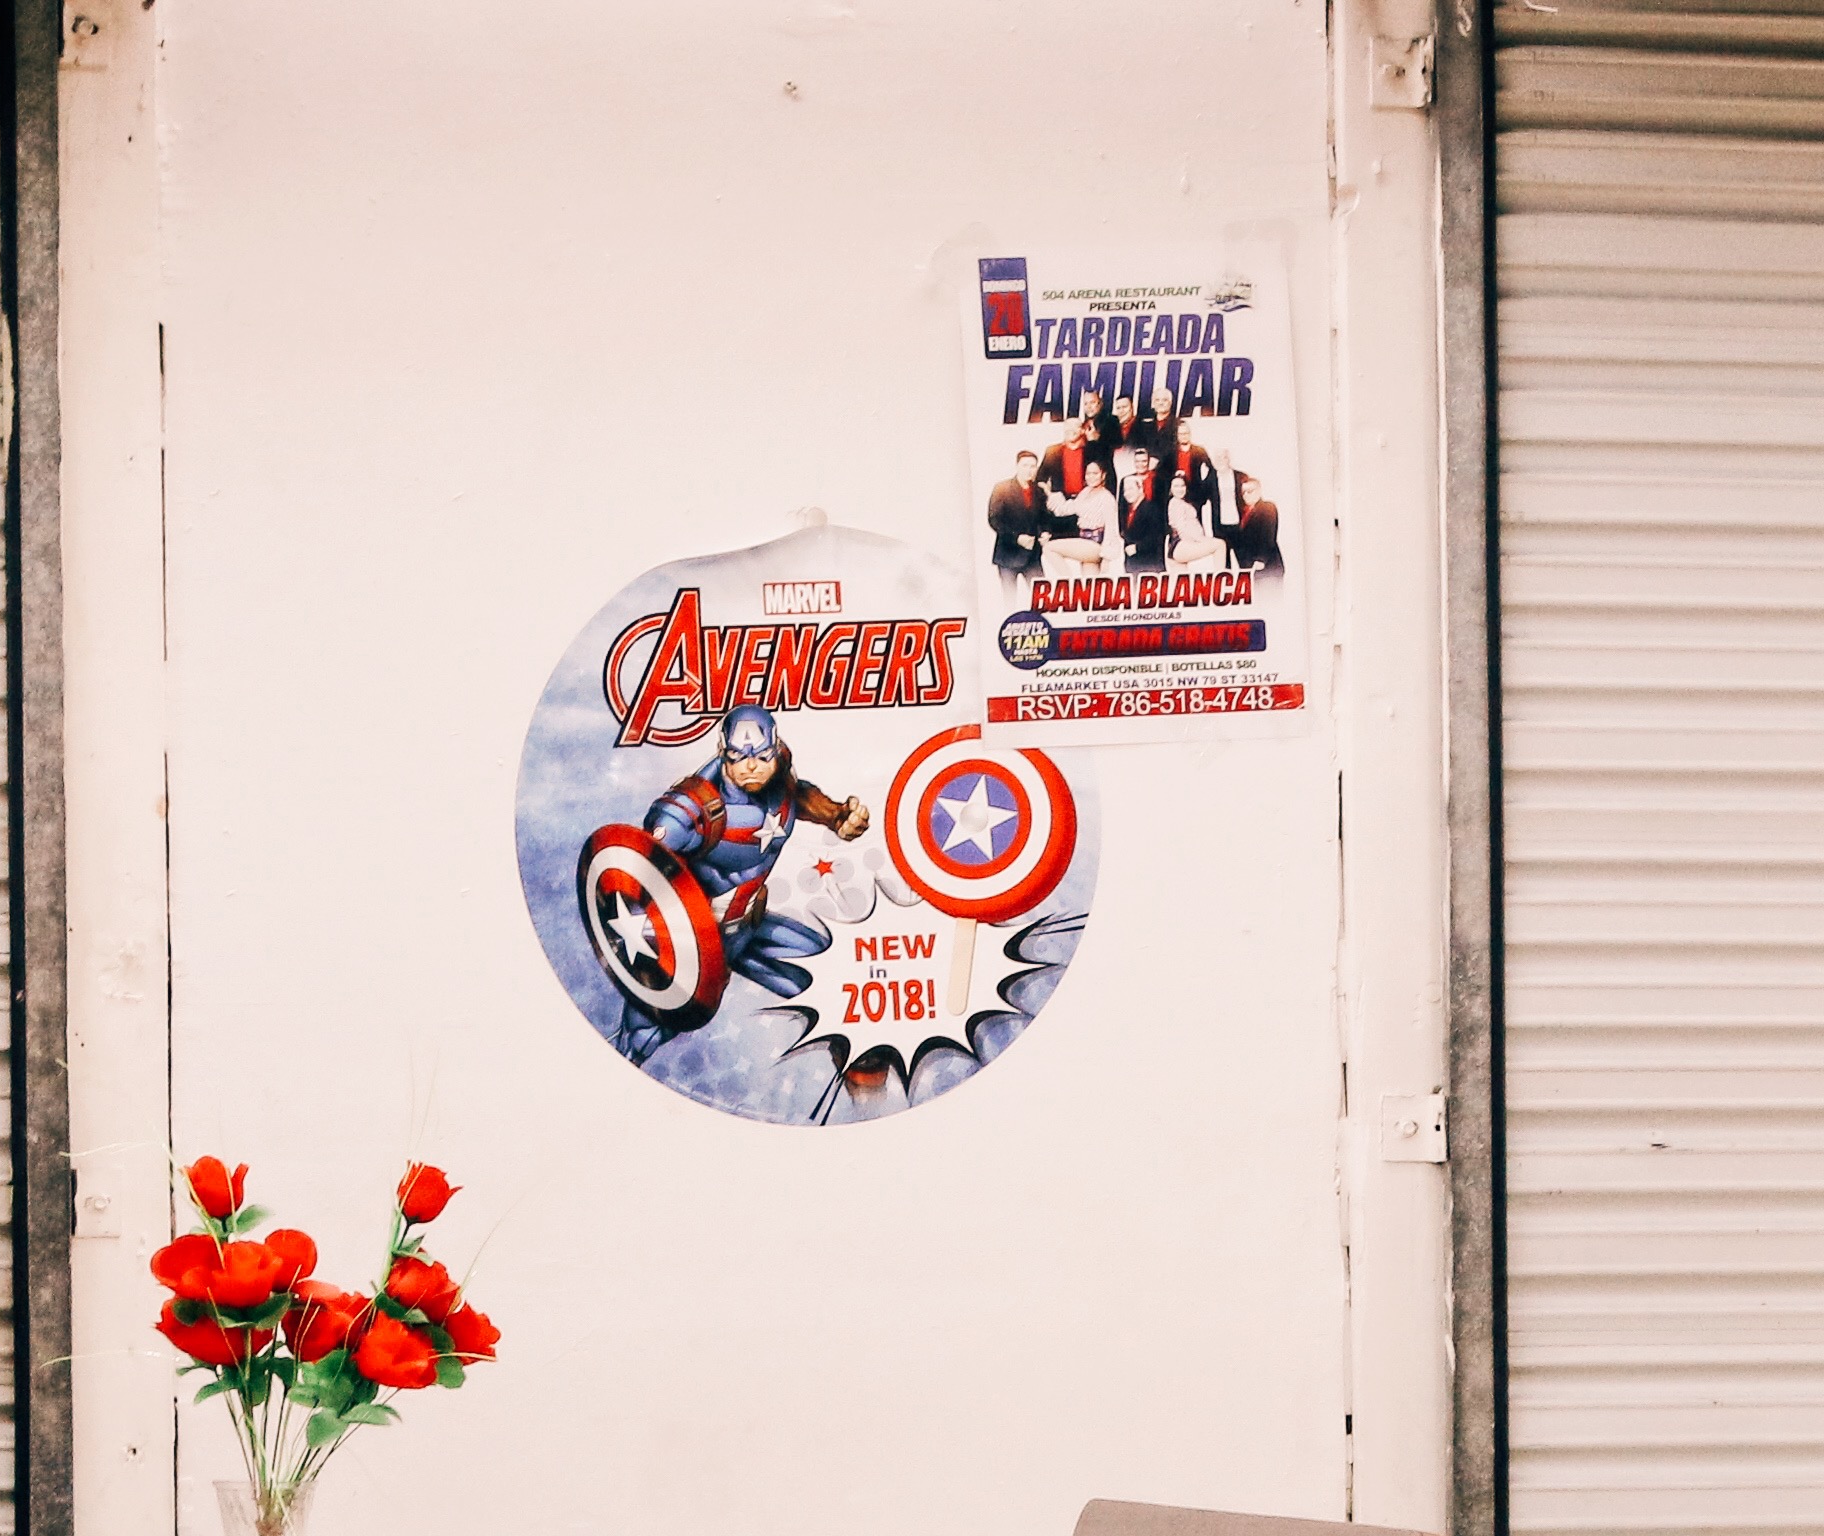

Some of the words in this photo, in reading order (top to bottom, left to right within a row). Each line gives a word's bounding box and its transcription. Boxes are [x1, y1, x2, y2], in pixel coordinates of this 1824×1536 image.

[1042, 290, 1065, 301] 504
[1067, 287, 1112, 300] ARENA
[1115, 285, 1202, 299] RESTAURANT
[1088, 300, 1157, 312] PRESENTA
[1034, 313, 1225, 359] TARDEADA
[1003, 357, 1254, 424] FAMILIAR
[762, 581, 841, 615] MARVEL
[1030, 576, 1131, 614] BANDA
[1136, 570, 1252, 610] BLANCA
[1086, 613, 1120, 624] DESDE
[1123, 611, 1183, 622] HONDURAS
[1003, 634, 1050, 651] 11AM
[1059, 626, 1162, 656] ENTRADA
[606, 587, 968, 749] AVENGERS
[1021, 680, 1108, 693] FLEAMARKET
[1113, 678, 1142, 690] USA
[1144, 677, 1174, 689] 3015
[1177, 676, 1199, 687] NW
[1221, 674, 1238, 685] ST
[1241, 672, 1279, 684] 33147
[1036, 666, 1089, 678] HOOKAH
[1092, 662, 1164, 676] DISPONIBLE
[1171, 659, 1234, 673] BOTELLAS
[1017, 694, 1098, 720] RSVP:
[1105, 685, 1275, 716] 786-518-4748
[854, 934, 936, 962] NEW
[869, 965, 887, 979] in
[842, 978, 936, 1024] 2018!
